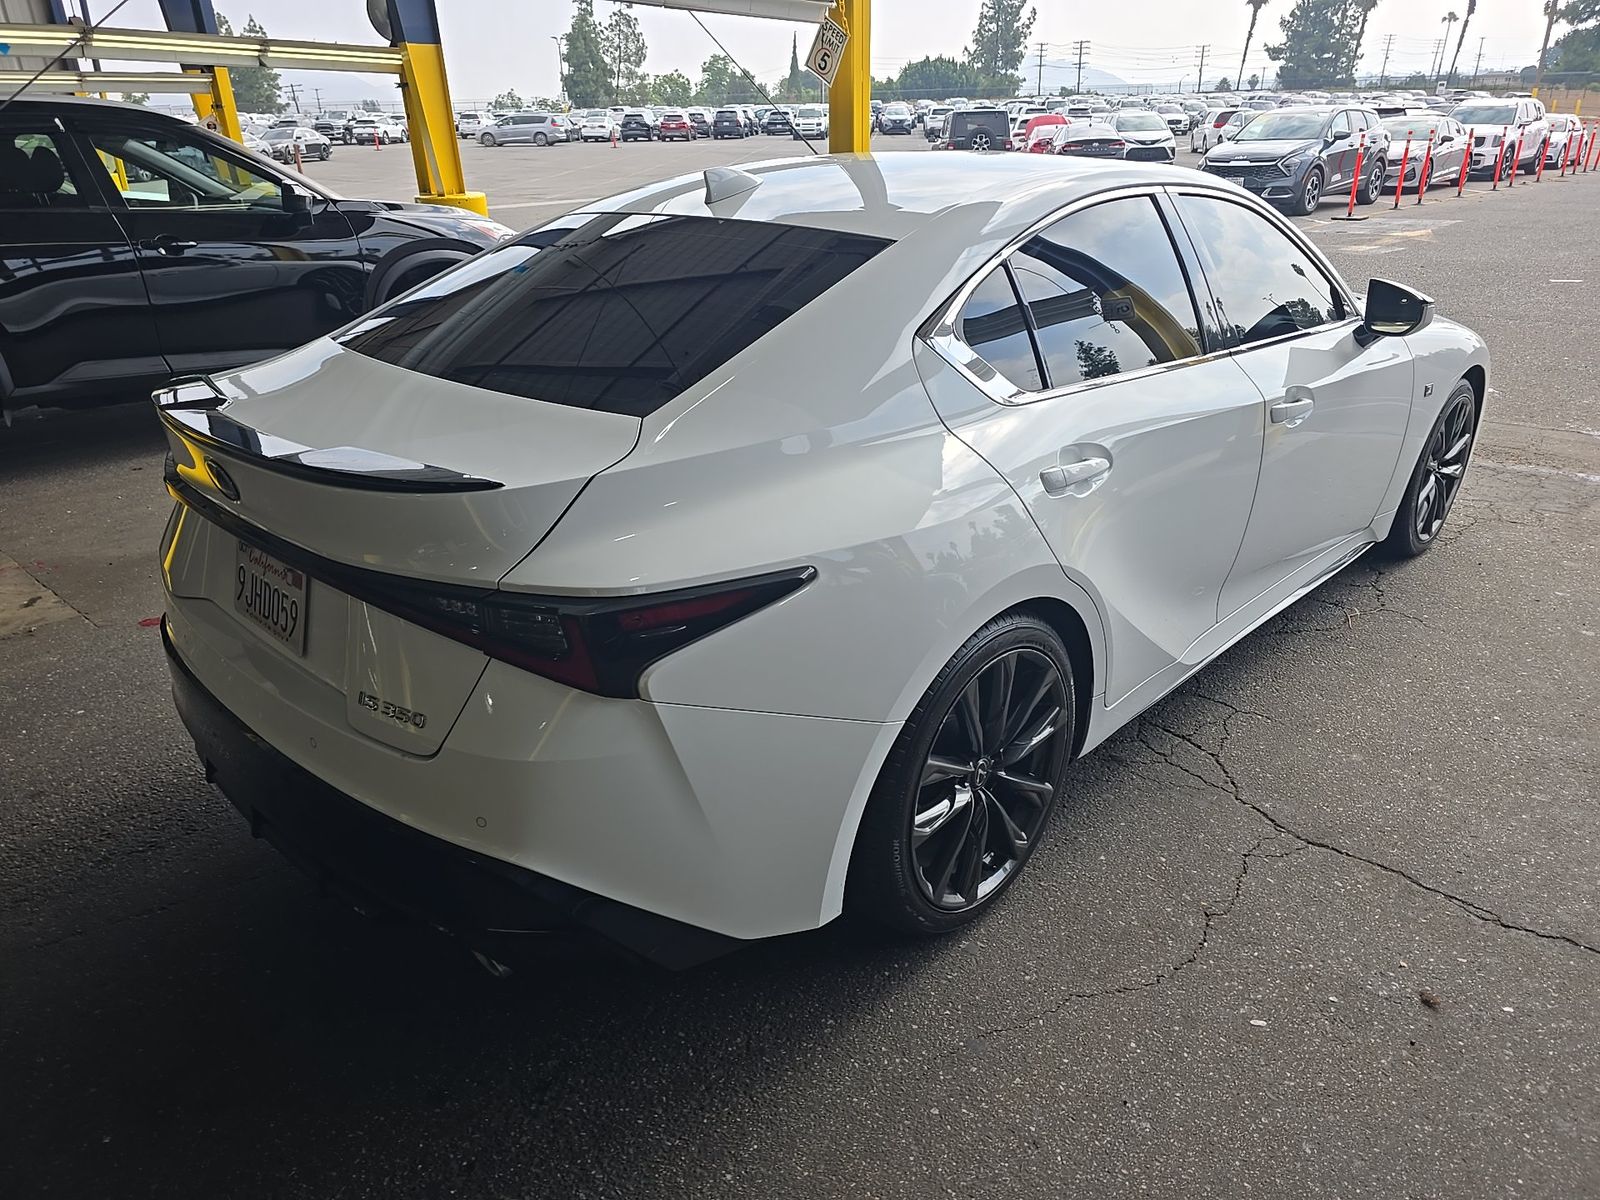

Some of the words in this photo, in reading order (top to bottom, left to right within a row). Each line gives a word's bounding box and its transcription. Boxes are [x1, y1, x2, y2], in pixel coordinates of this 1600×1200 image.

[822, 21, 845, 44] SPEED
[817, 51, 831, 71] 5
[237, 564, 299, 638] 9JHD059
[380, 701, 427, 729] 350
